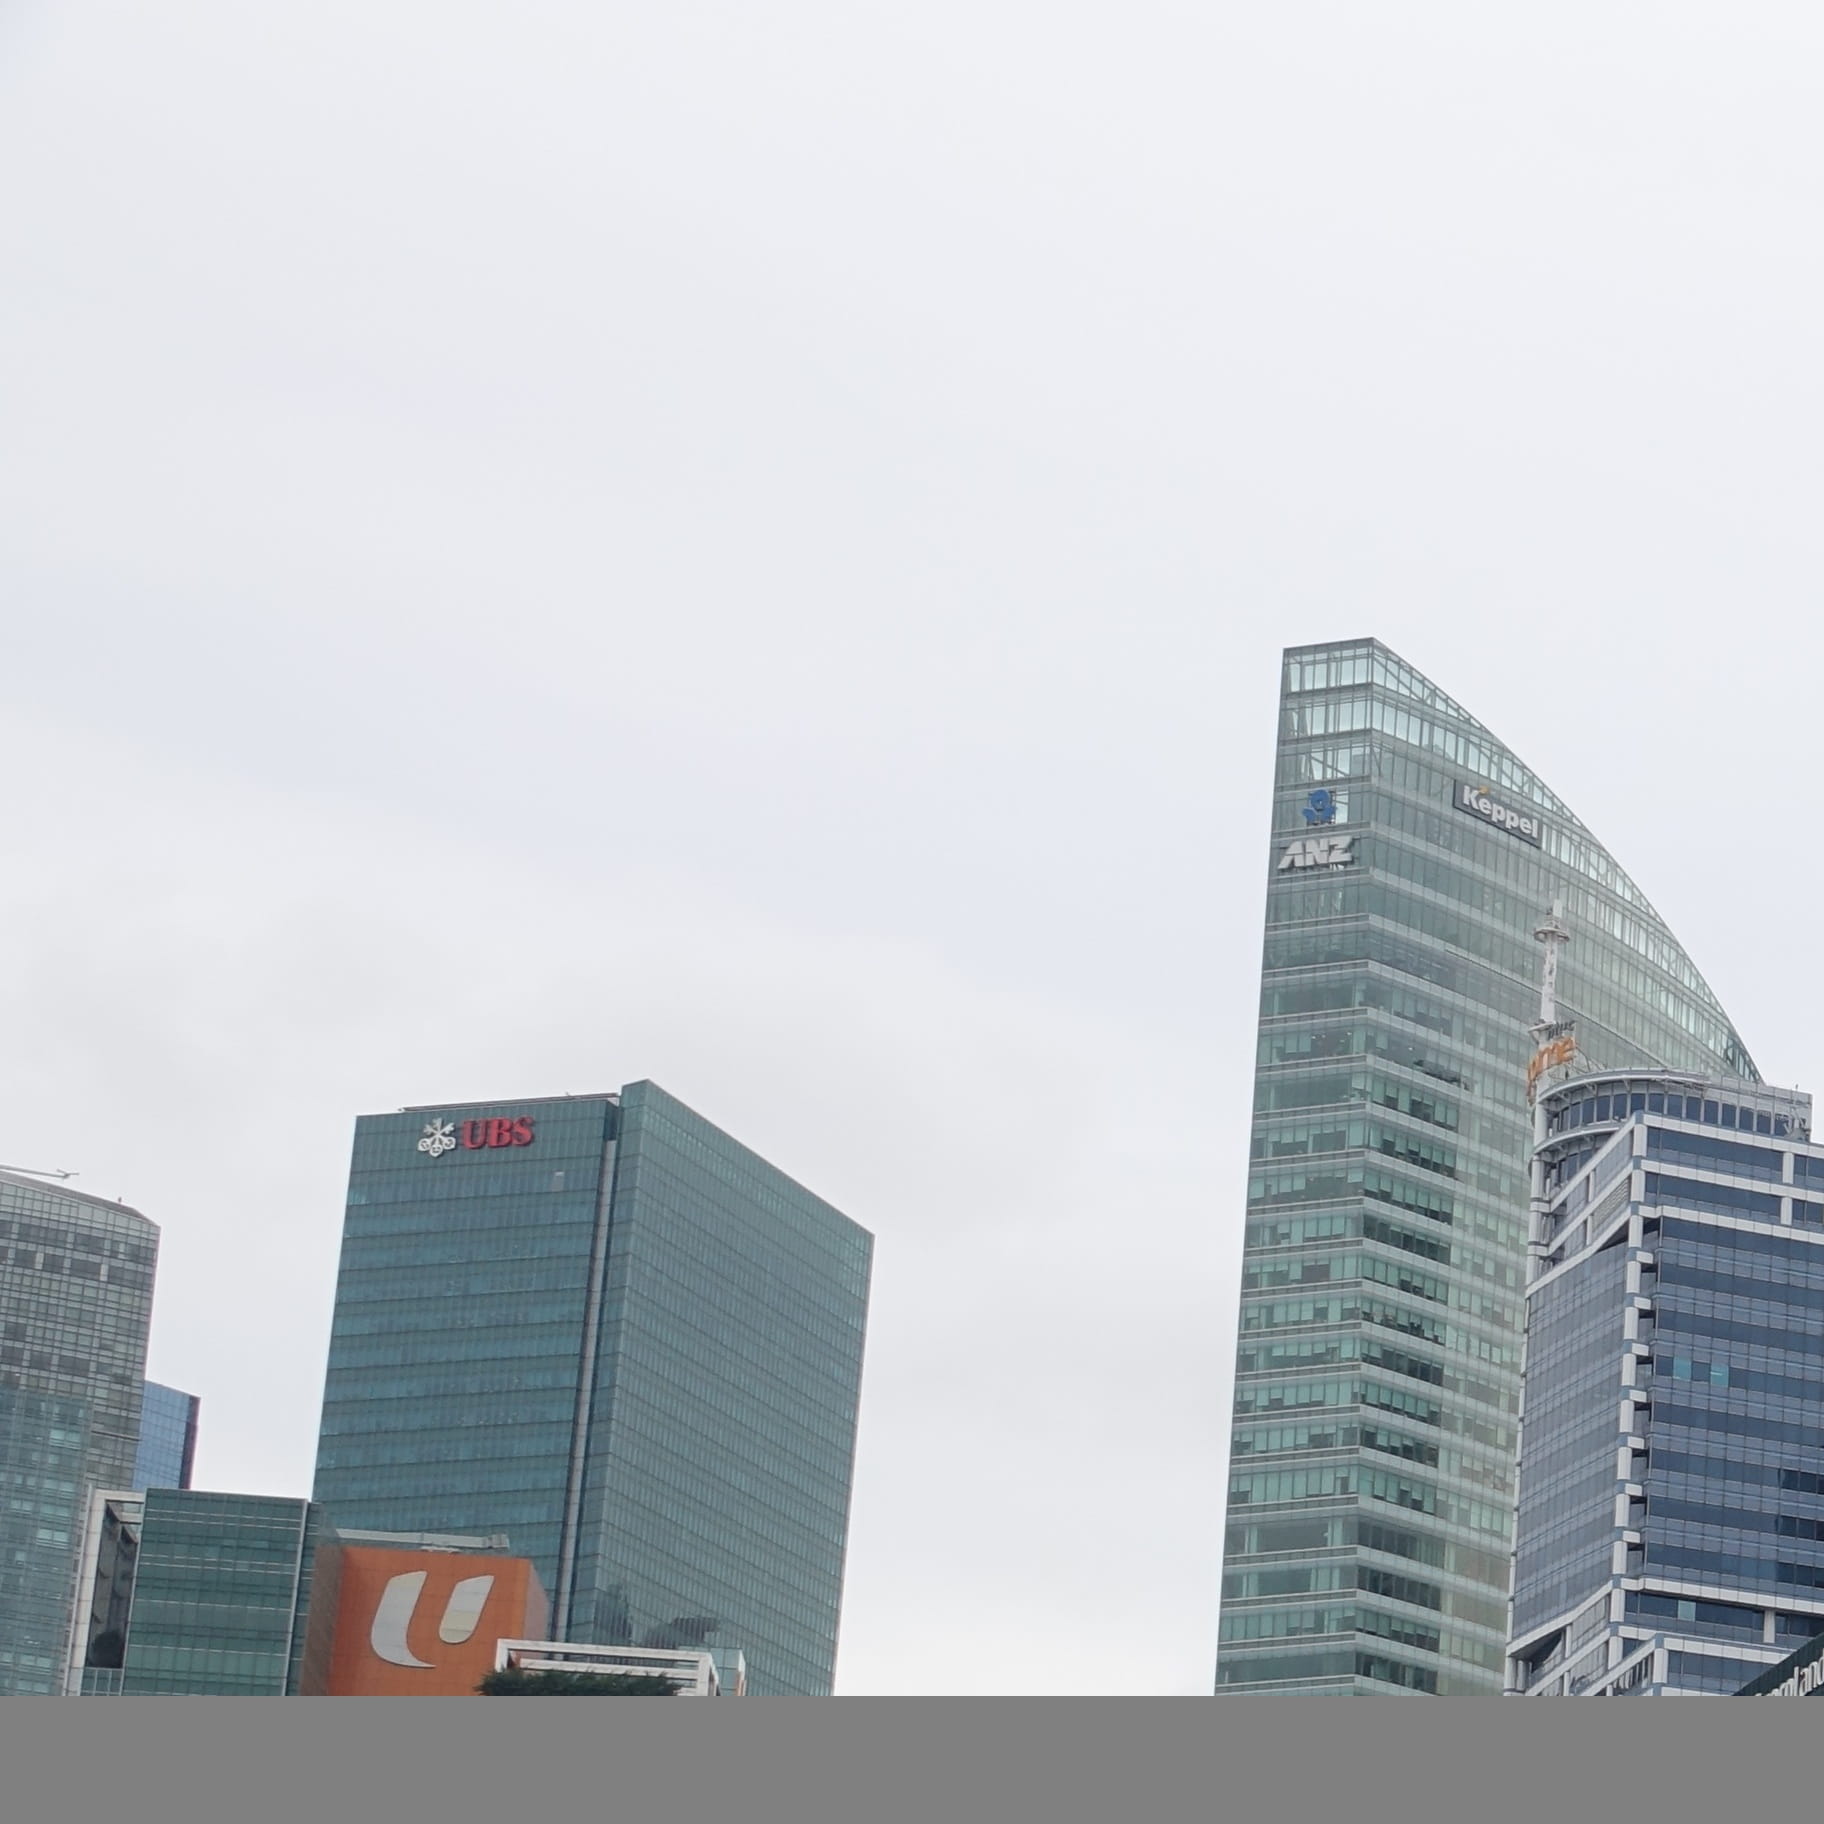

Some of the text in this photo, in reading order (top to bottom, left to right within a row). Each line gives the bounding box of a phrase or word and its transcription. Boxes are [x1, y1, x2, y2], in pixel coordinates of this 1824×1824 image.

[1462, 784, 1539, 839] Keppel
[1277, 836, 1356, 870] ANZ
[463, 1115, 534, 1150] UBS
